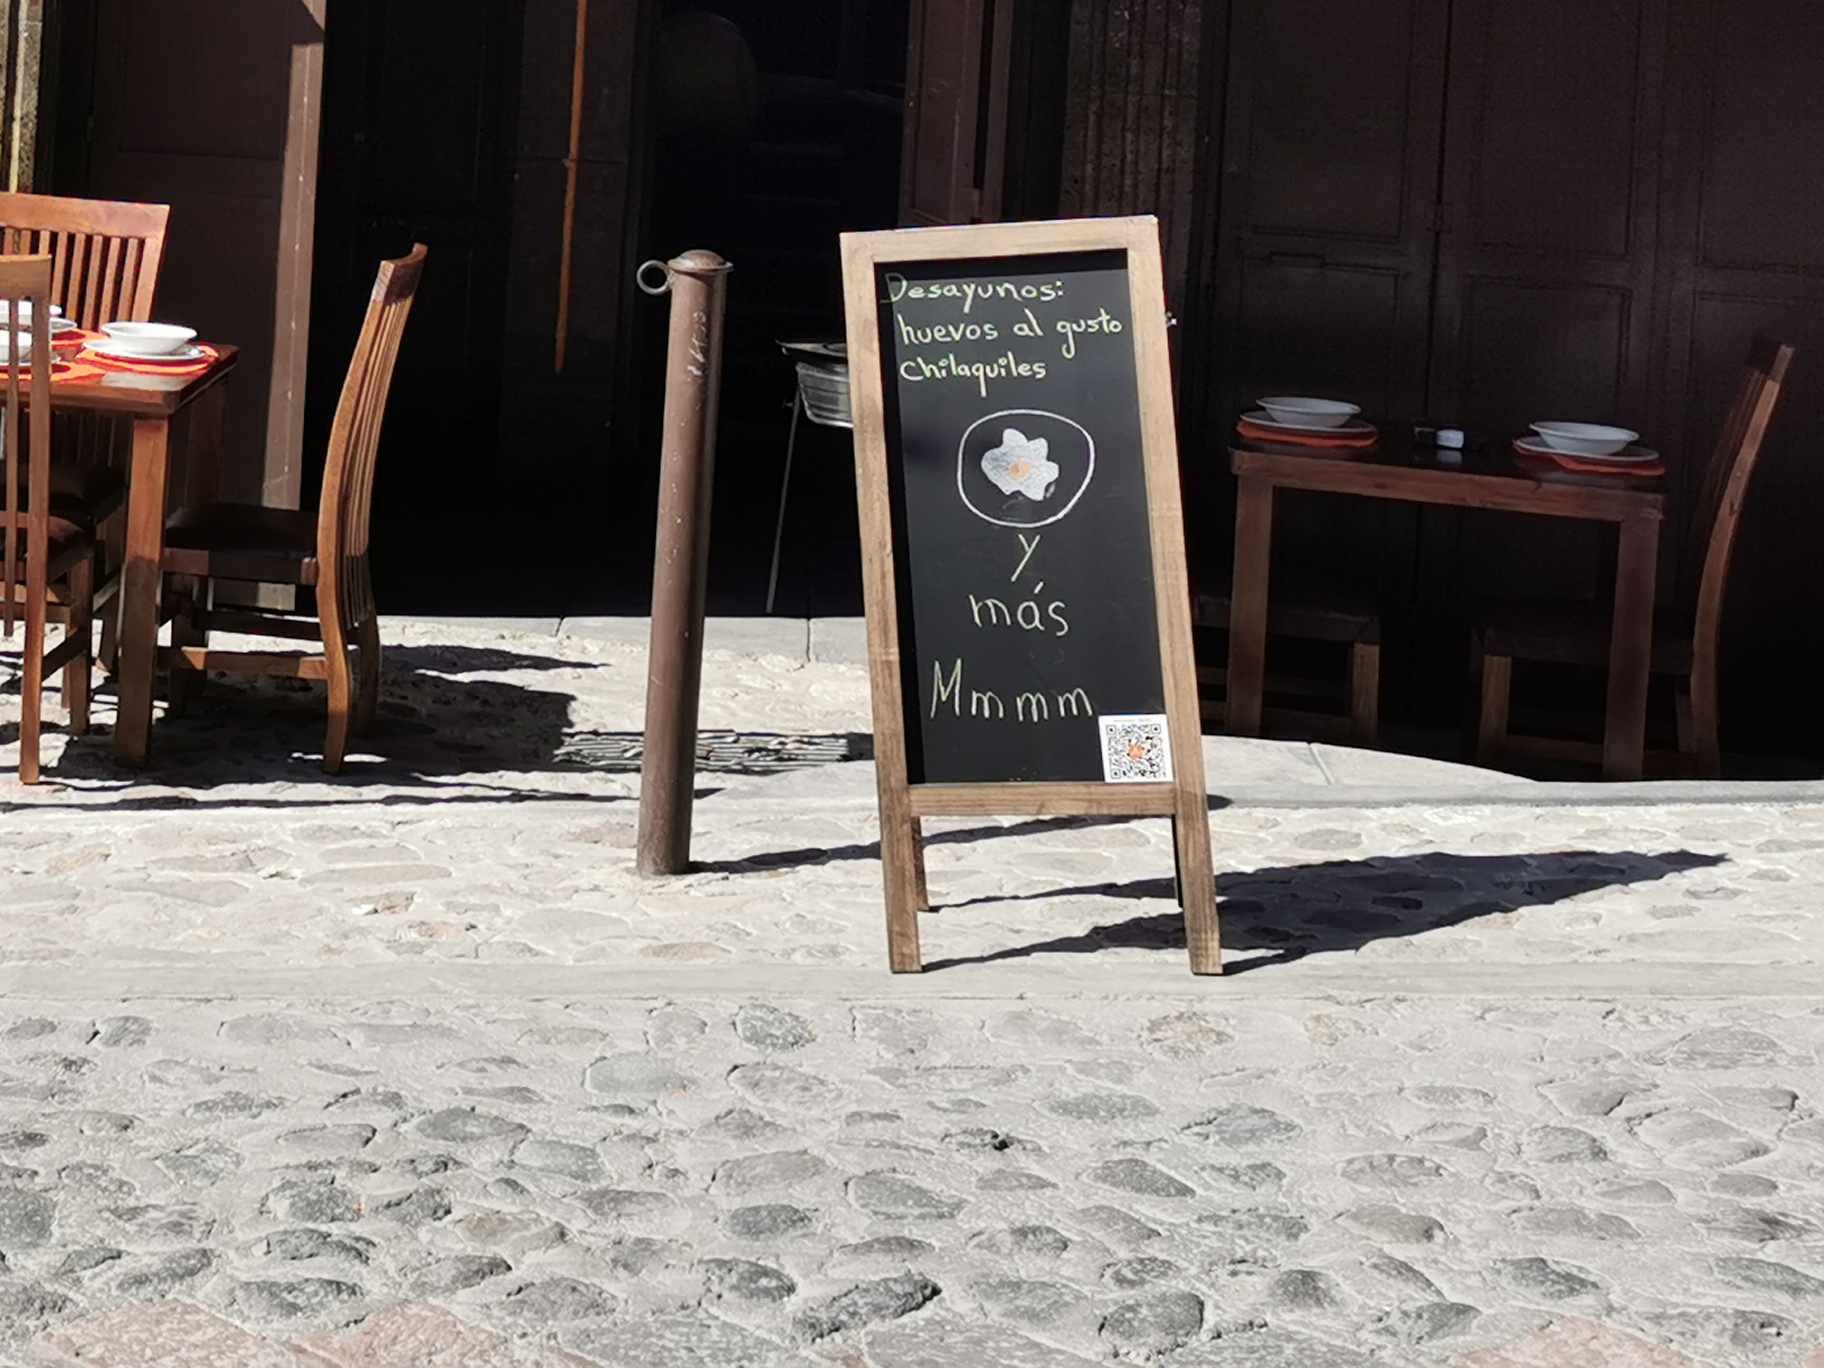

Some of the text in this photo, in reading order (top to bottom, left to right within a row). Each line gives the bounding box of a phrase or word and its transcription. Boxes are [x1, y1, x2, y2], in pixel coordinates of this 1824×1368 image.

[882, 272, 1064, 314] Desayunos:
[896, 307, 1123, 360] huevos al gusto
[968, 580, 1069, 637] más
[930, 656, 1094, 723] Mmmm
